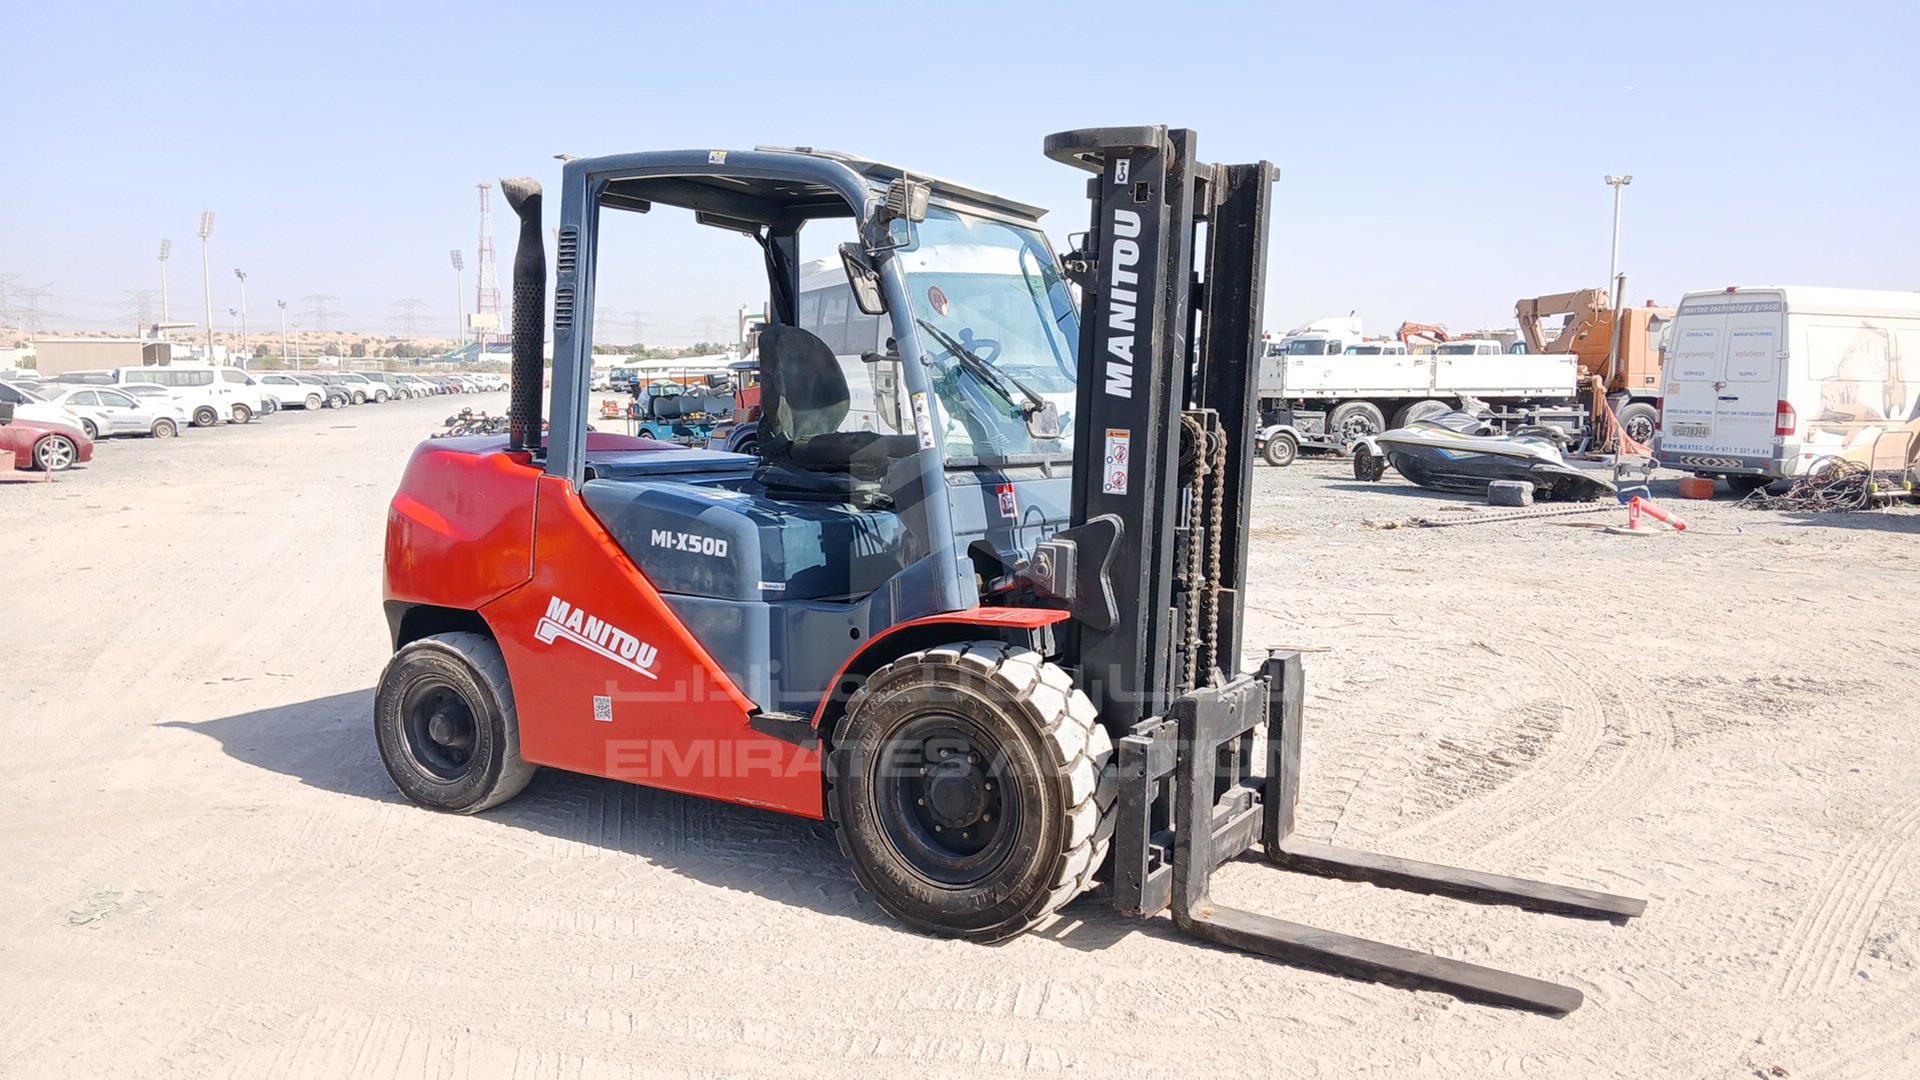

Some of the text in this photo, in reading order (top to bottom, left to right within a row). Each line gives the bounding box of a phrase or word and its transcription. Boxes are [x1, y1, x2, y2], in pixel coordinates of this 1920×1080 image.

[1105, 209, 1142, 398] MANITOU
[1710, 303, 1754, 313] technology
[1755, 302, 1779, 312] group
[1678, 351, 1715, 359] engineering
[651, 529, 728, 558] MI-X50D
[545, 595, 658, 669] MANITOU
